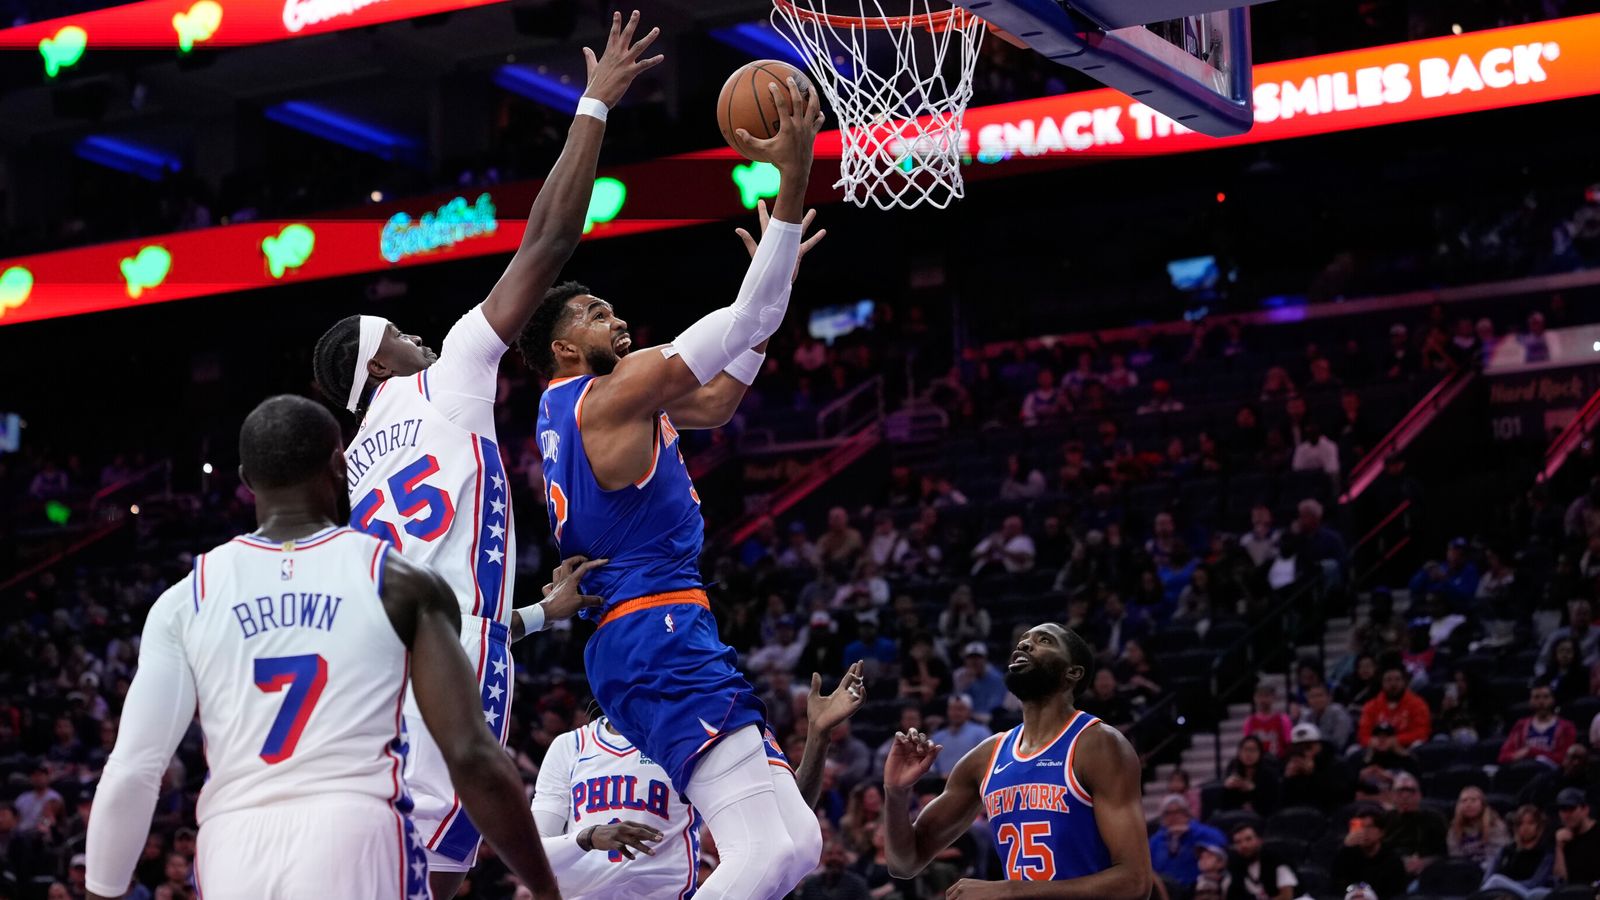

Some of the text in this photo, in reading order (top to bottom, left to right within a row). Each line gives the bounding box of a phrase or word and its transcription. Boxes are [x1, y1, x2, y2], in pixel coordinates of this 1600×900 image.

[977, 106, 1124, 163] SNACK
[1253, 63, 1412, 123] SMILES
[349, 454, 455, 554] 55
[232, 592, 342, 639] BROWN
[253, 653, 328, 765] 7
[572, 775, 670, 822] PHILA
[985, 783, 1070, 821] NEW YORK
[998, 820, 1056, 881] 25
